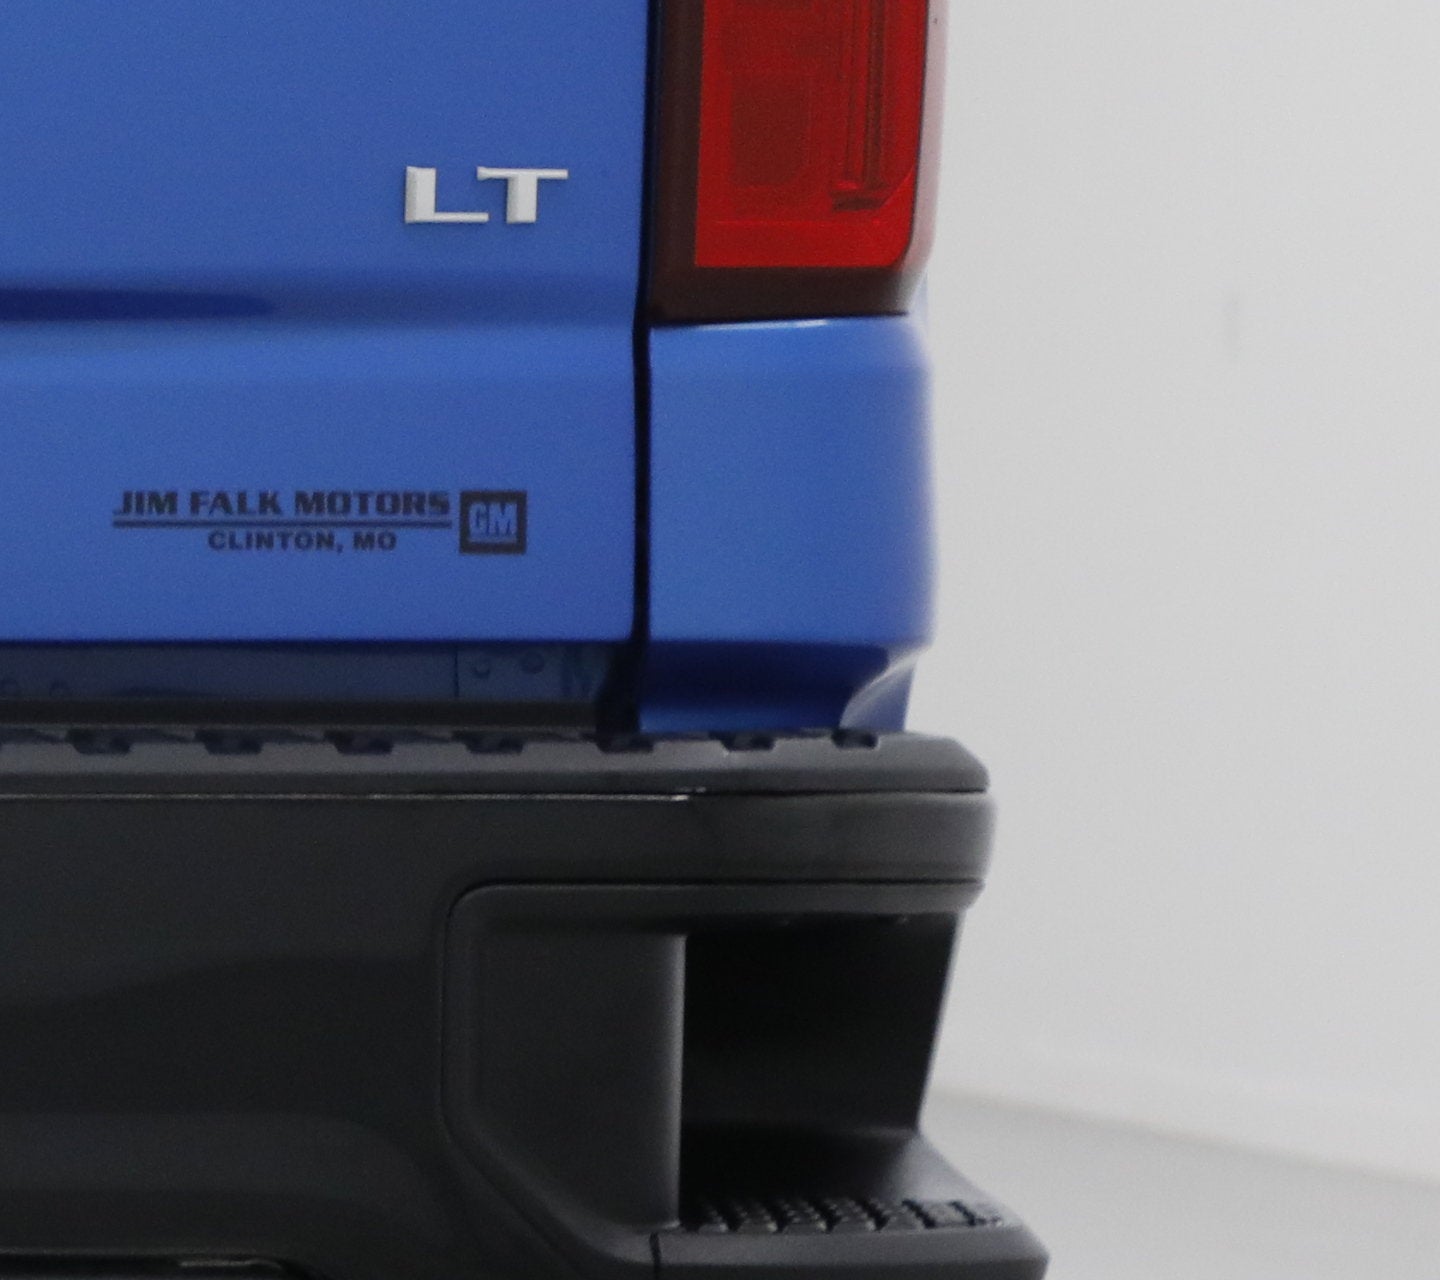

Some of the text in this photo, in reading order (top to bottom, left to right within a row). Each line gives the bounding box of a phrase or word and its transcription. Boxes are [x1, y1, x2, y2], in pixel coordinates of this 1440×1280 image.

[403, 165, 569, 224] LT
[113, 490, 451, 516] JIM FALK MOTORS
[207, 531, 398, 553] CLINTON, MO
